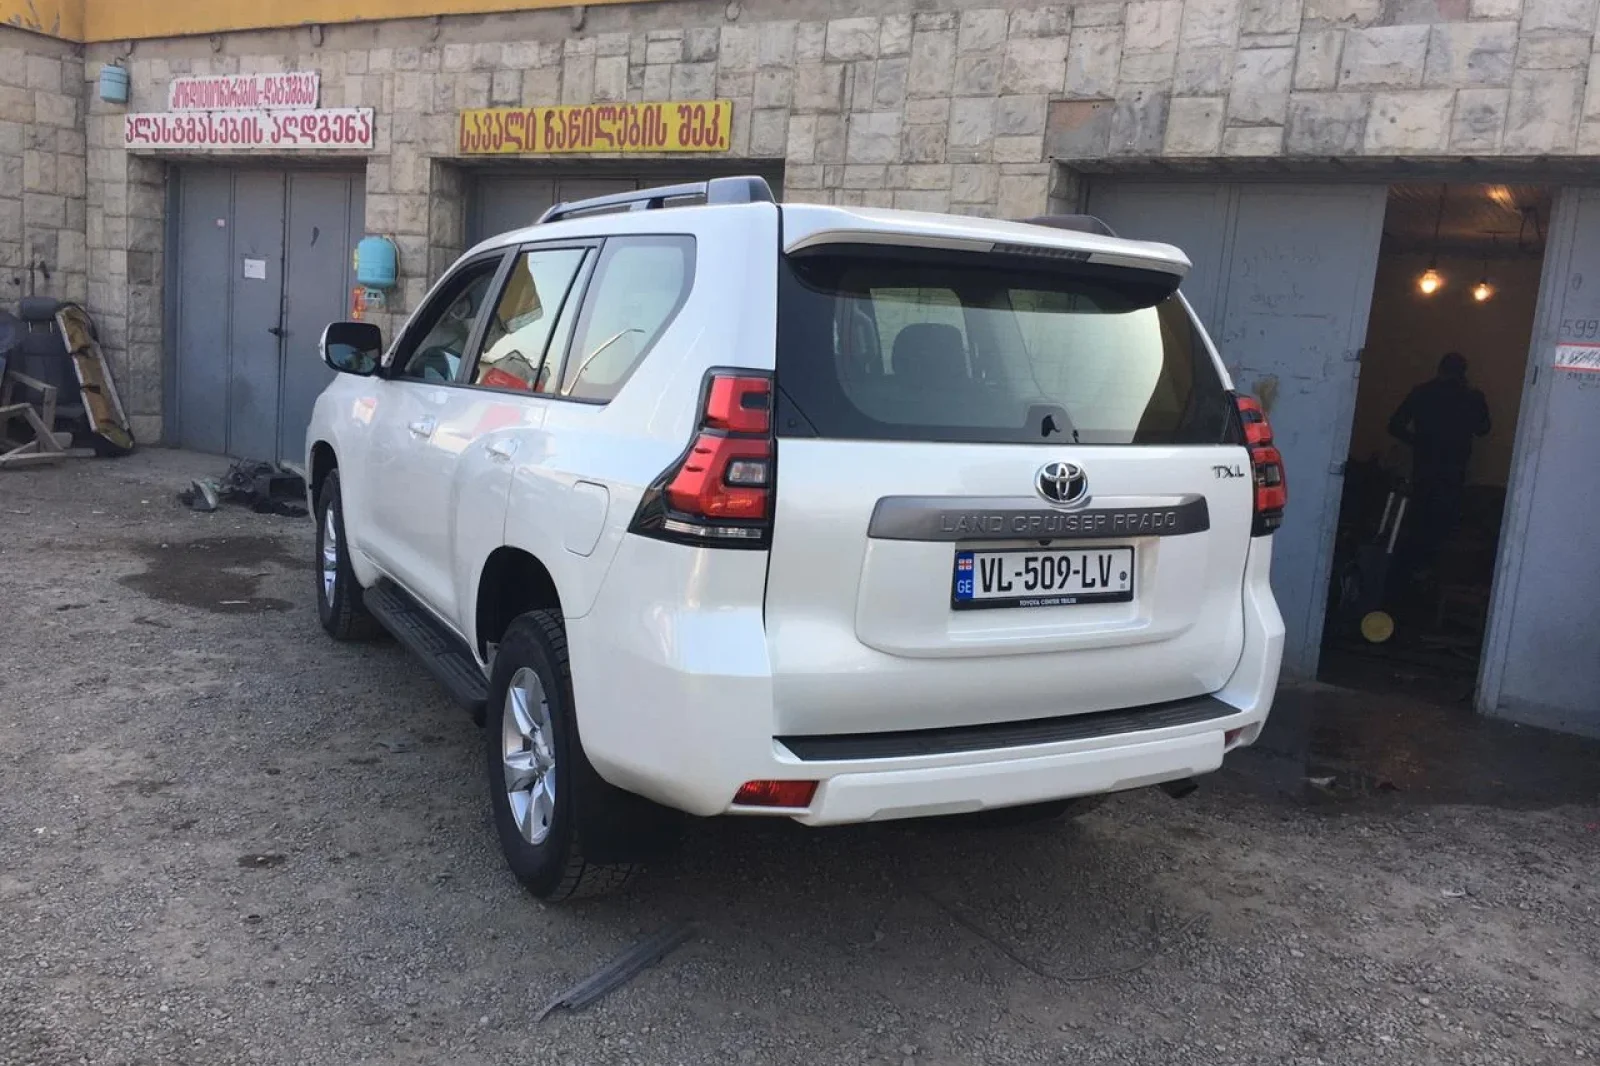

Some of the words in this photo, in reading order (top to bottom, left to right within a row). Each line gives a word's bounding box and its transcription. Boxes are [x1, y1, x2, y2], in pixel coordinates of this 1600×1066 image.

[125, 117, 263, 144] პლასტმასების
[270, 114, 371, 144] აღდგენა
[459, 108, 537, 151] სავალი
[543, 103, 668, 149] ნაწილების
[938, 515, 1003, 533] LAND
[1011, 514, 1106, 533] CRUISER
[1112, 511, 1177, 531] PRADO
[957, 579, 973, 594] GE
[979, 554, 1112, 593] VL-509-LV
